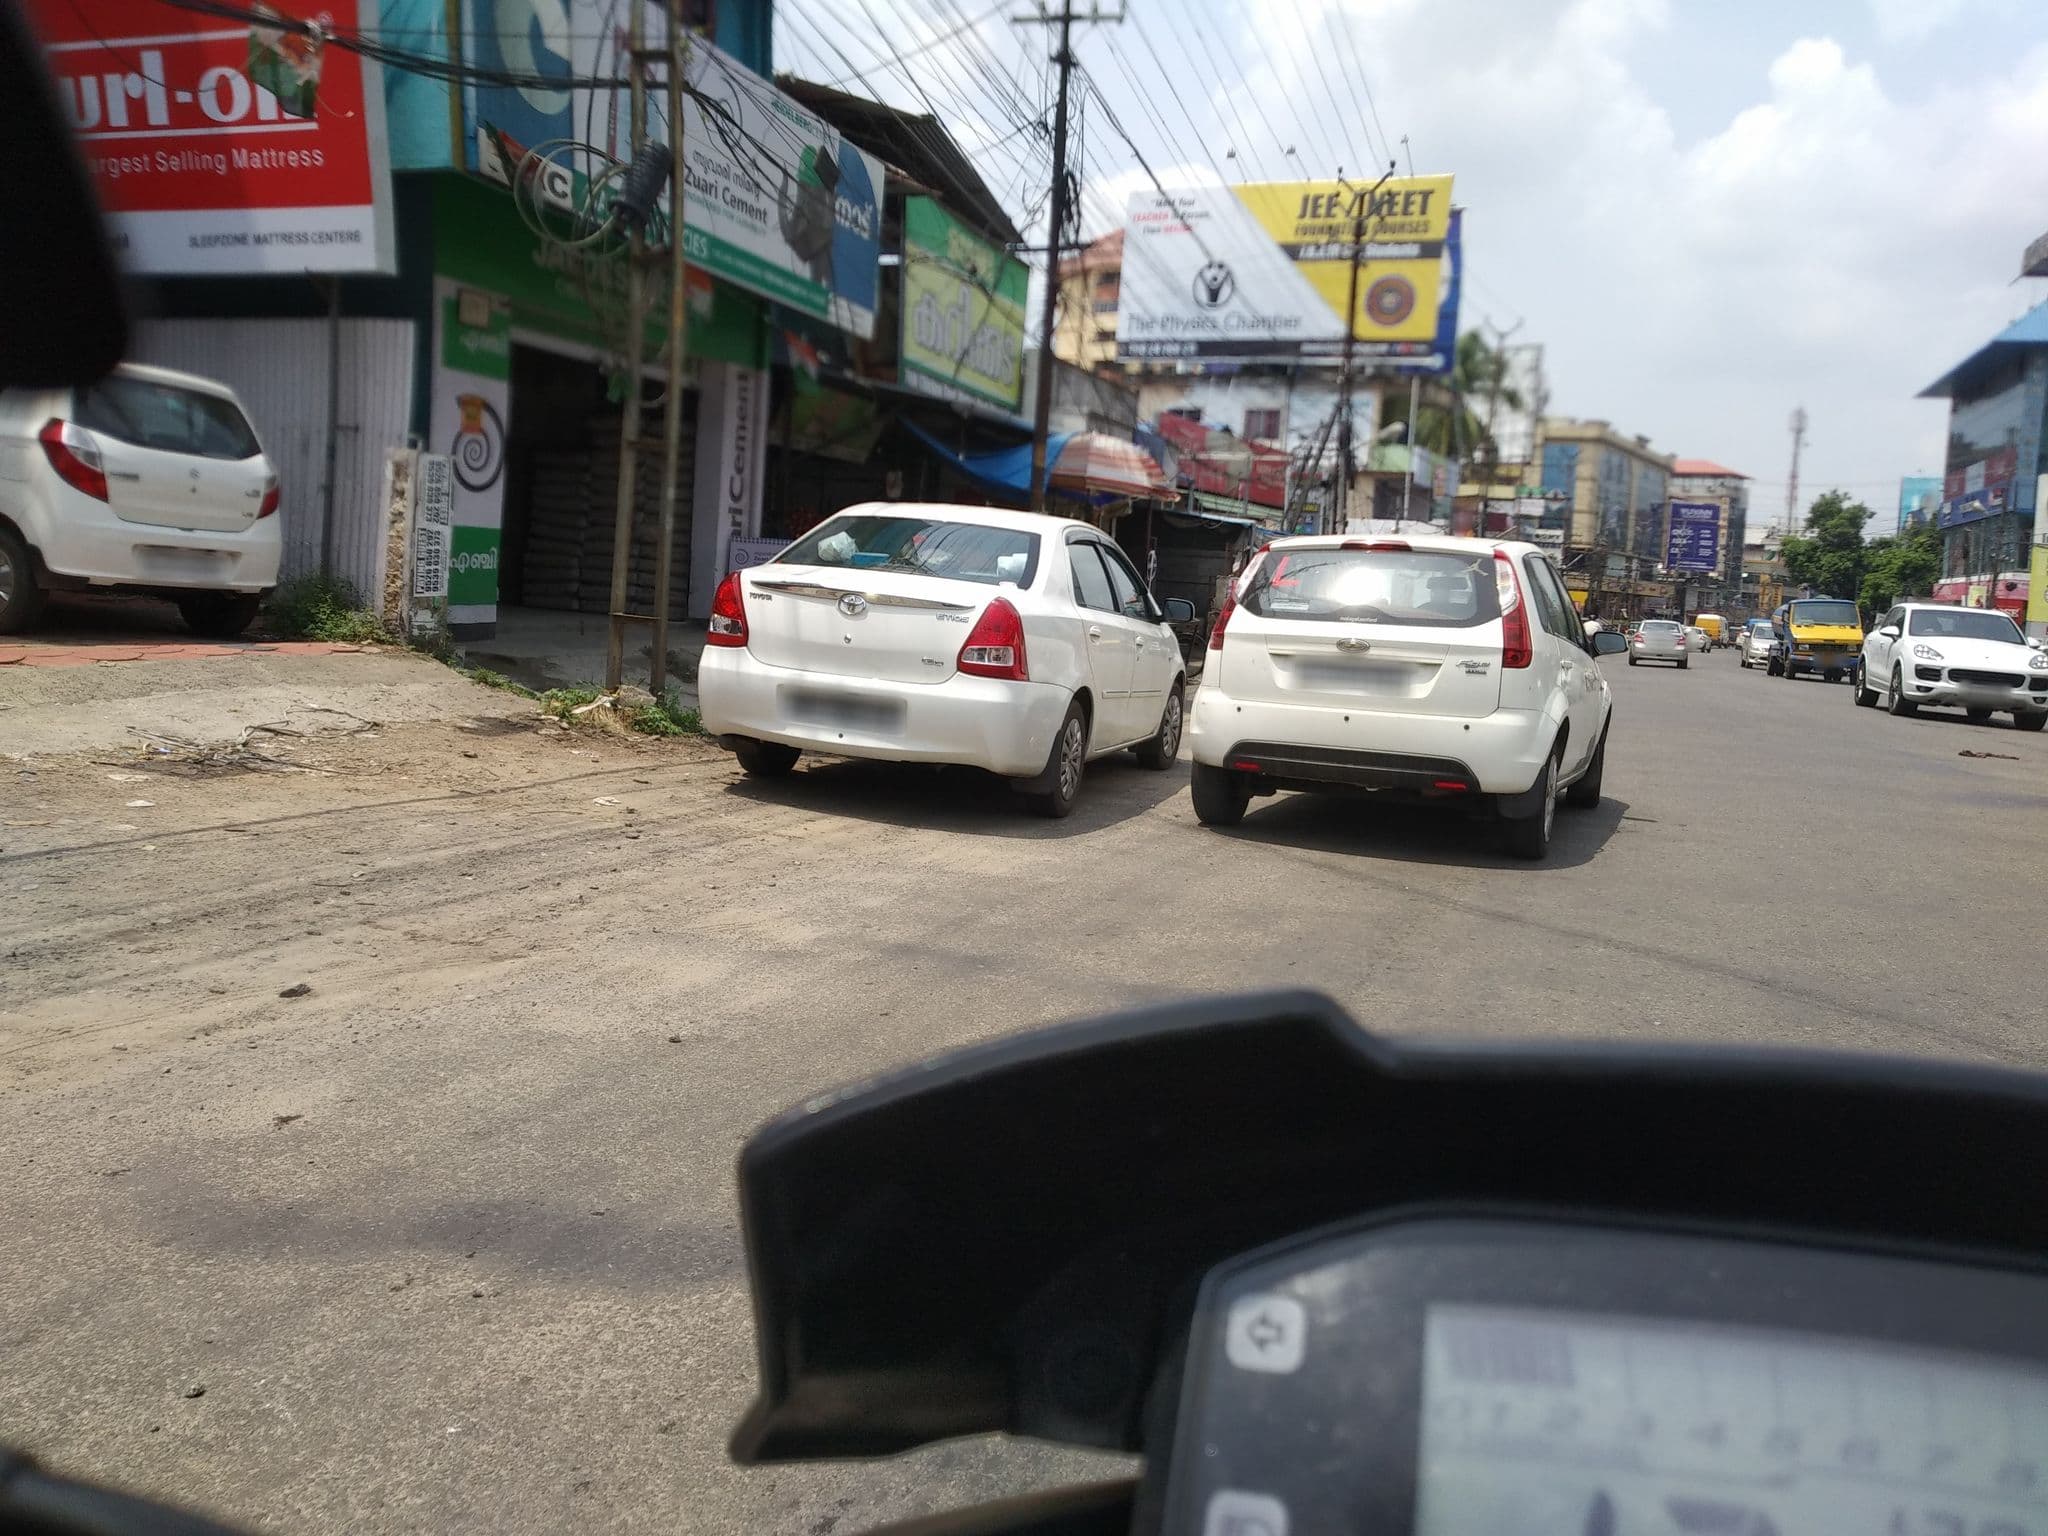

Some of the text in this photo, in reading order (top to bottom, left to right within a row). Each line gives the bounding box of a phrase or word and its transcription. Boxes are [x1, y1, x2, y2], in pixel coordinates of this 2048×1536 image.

[60, 50, 318, 128] url-o
[89, 147, 325, 178] argest Selling Mattress
[684, 168, 718, 199] Zuari
[721, 186, 768, 225] Cement
[1298, 190, 1341, 219] JEE
[1364, 187, 1435, 217] NEET
[252, 231, 309, 246] MATTRESS
[680, 228, 707, 258] CIES
[1127, 313, 1154, 333] The
[729, 373, 748, 503] Cement
[749, 591, 773, 602] TOYOTA
[935, 611, 970, 623] ETIOS
